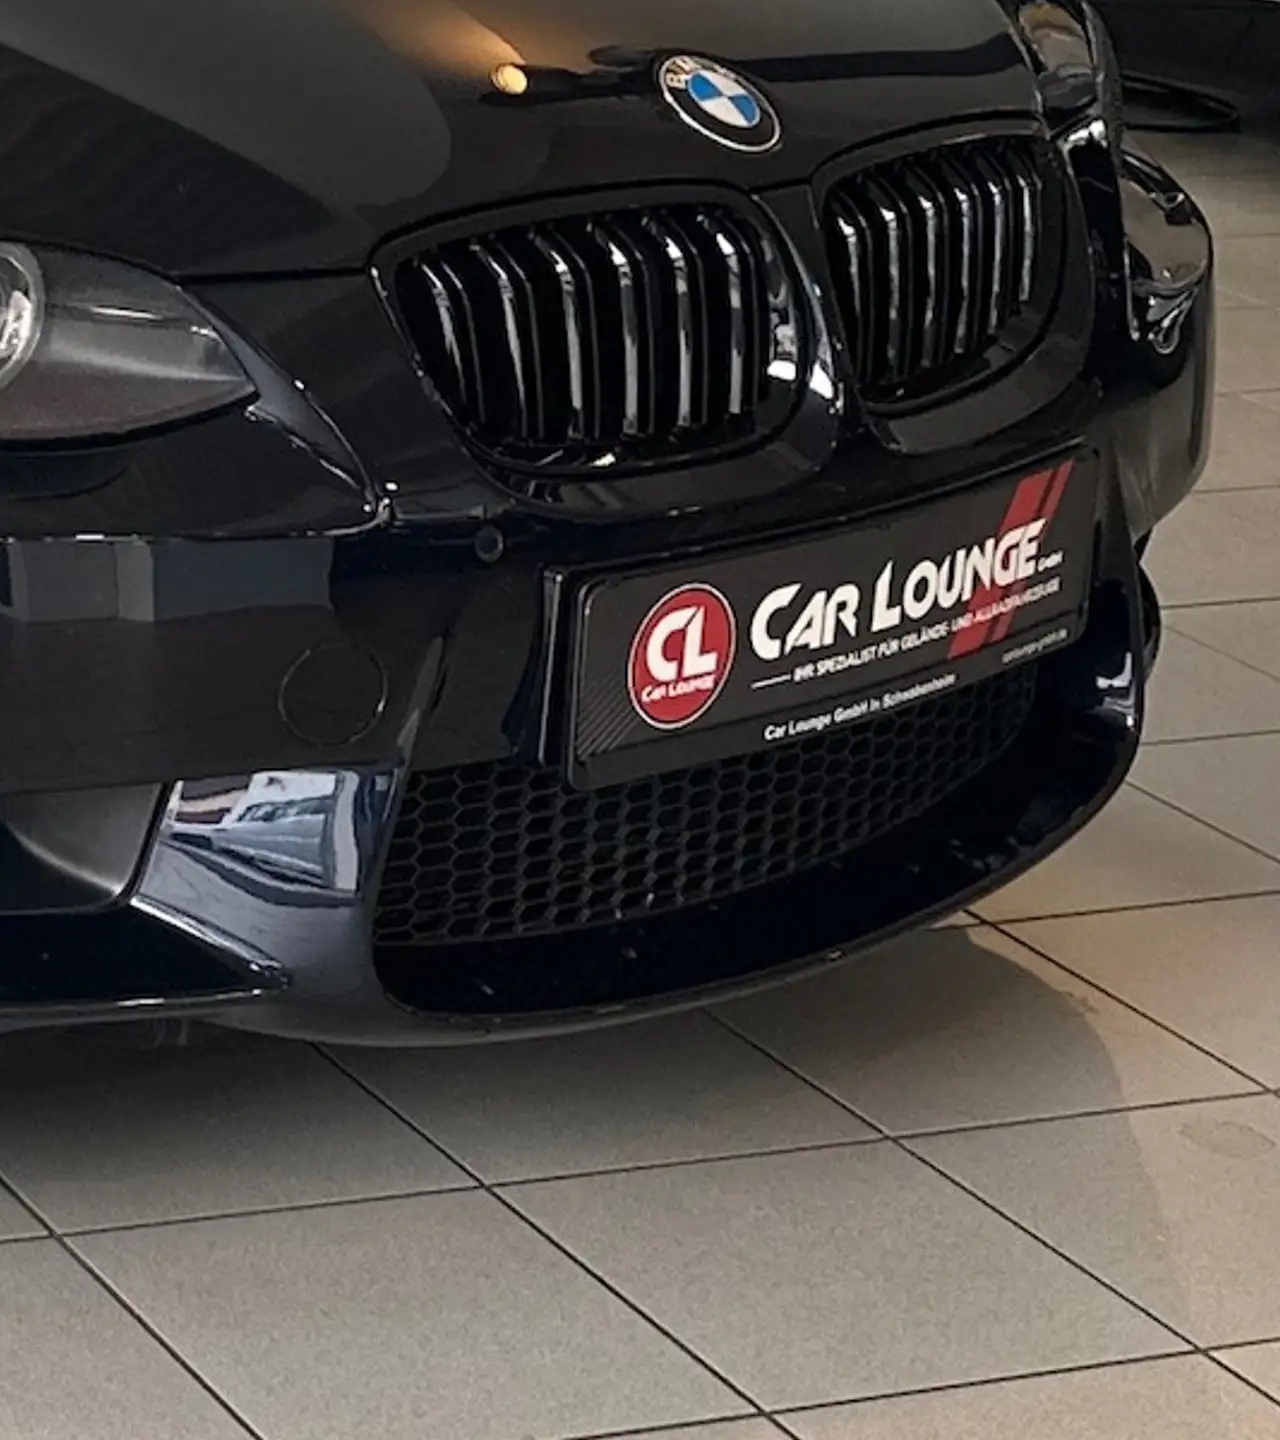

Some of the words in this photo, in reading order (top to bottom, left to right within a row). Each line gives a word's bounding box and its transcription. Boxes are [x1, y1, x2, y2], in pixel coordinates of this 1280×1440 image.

[750, 583, 860, 660] CAR
[871, 518, 1047, 633] LOUNGE
[646, 605, 718, 682] CL
[764, 723, 787, 741] Car
[788, 713, 832, 736] Lounge
